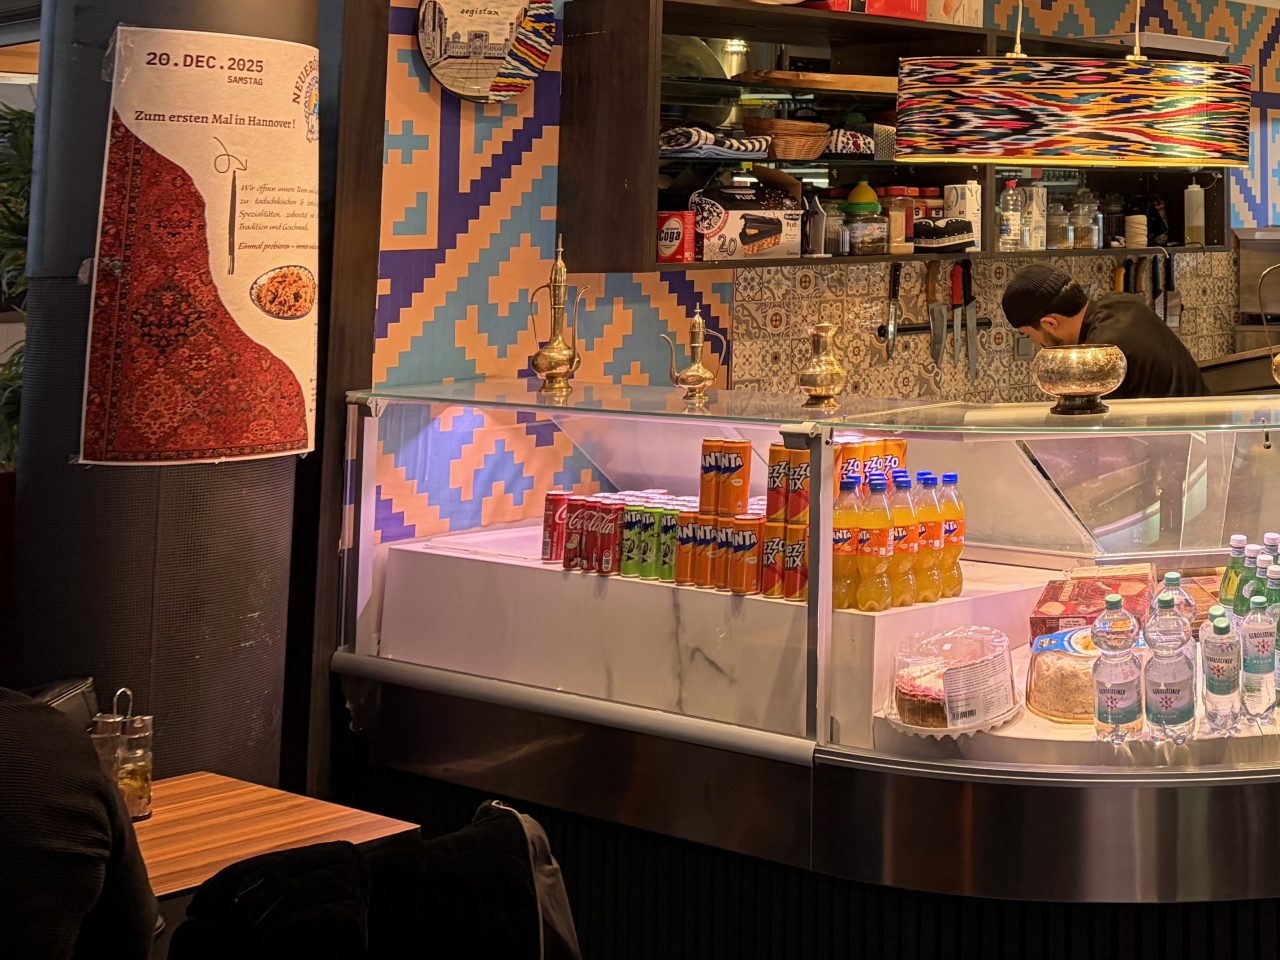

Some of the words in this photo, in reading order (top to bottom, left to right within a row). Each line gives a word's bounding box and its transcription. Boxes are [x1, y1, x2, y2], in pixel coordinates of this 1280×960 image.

[145, 51, 264, 73] 20.DEC.2025
[227, 75, 264, 86] SAMSTAG
[134, 110, 166, 122] Zum
[168, 114, 209, 124] ersten
[211, 113, 233, 125] Mal
[235, 116, 246, 126] in
[247, 115, 296, 129] Hannover!
